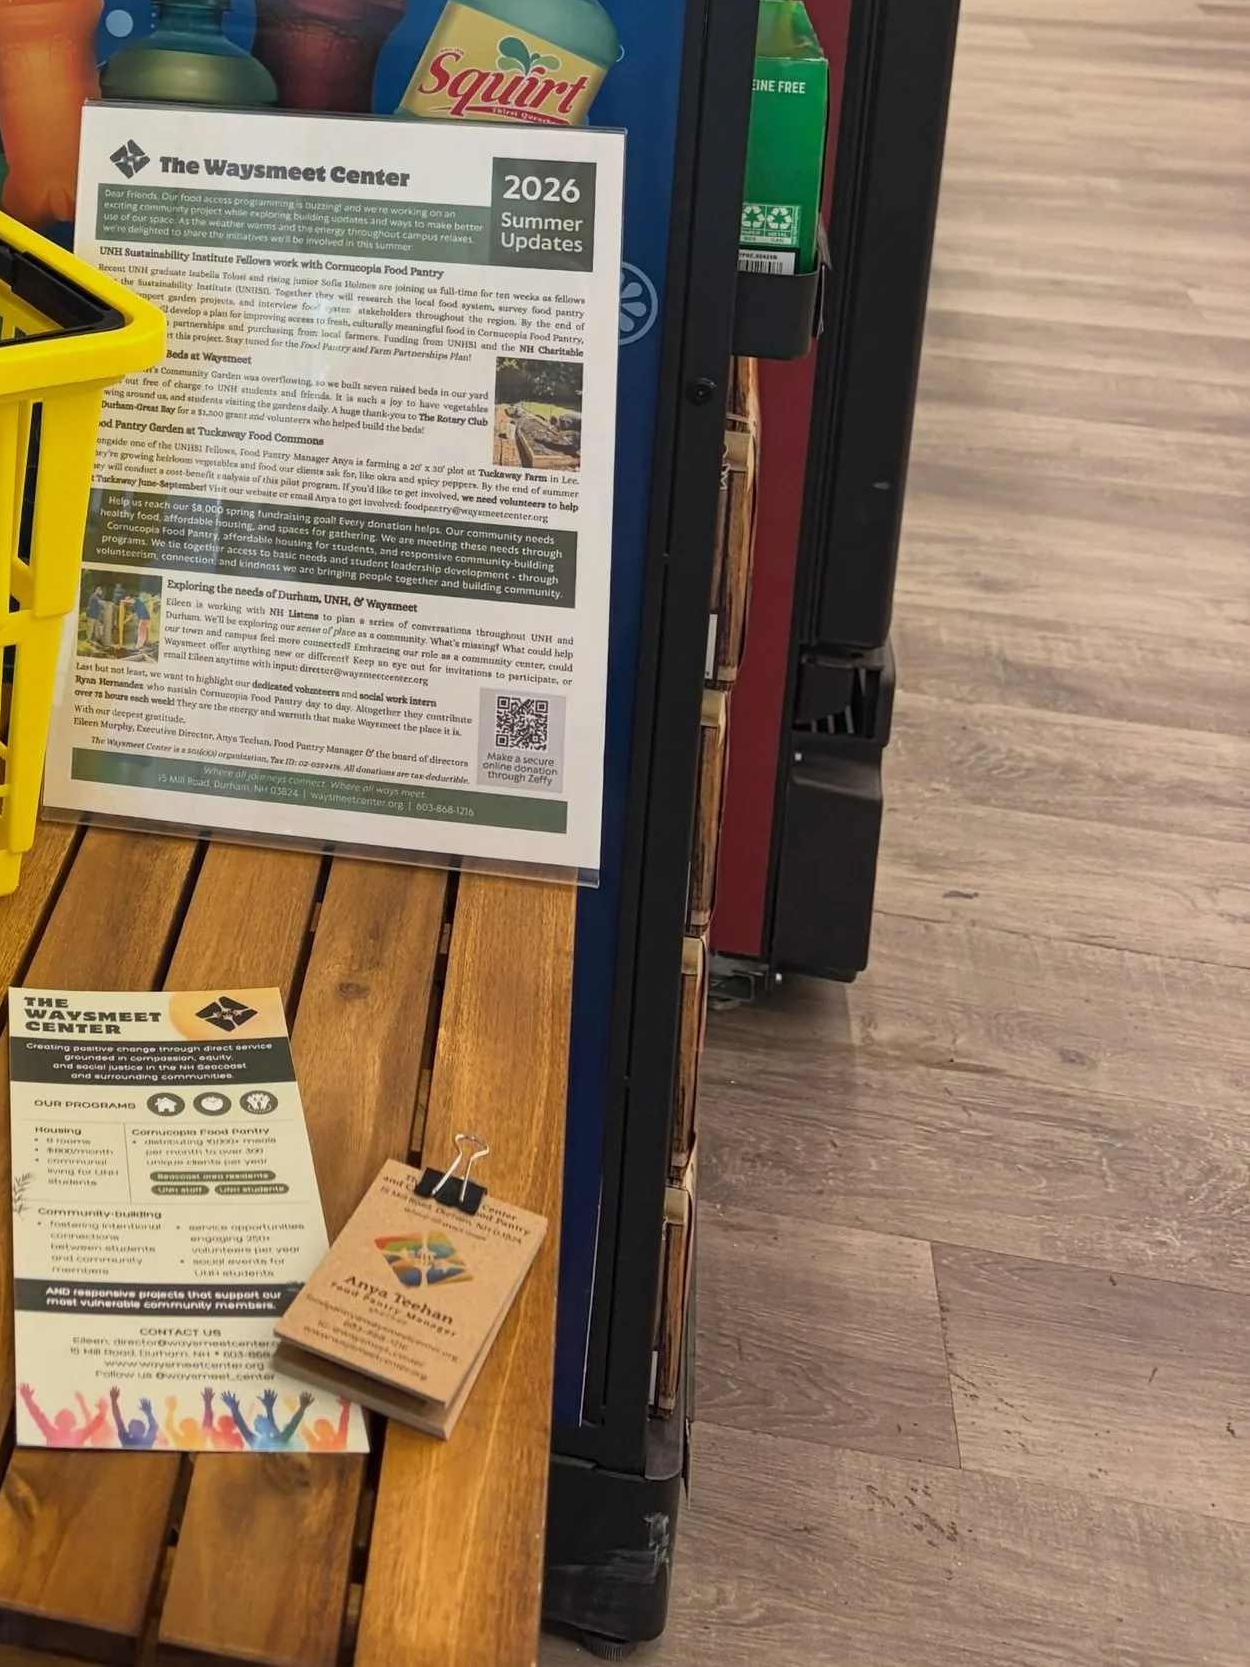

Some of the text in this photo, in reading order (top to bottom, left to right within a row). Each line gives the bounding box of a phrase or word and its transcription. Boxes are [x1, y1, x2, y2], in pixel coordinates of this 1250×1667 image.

[417, 51, 588, 117] Squirt
[777, 79, 806, 95] FREE
[159, 156, 410, 187] The Waysmeet Center
[502, 175, 581, 203] 2026
[500, 212, 584, 232] Summer
[500, 232, 584, 253] Updates
[487, 752, 513, 763] Make
[522, 757, 555, 767] secure
[483, 762, 558, 775] online donation
[487, 770, 553, 786] through Zeffy
[24, 996, 69, 1008] THE
[24, 1008, 162, 1022] WAYSMEET
[25, 1021, 121, 1034] CENTER
[34, 1100, 136, 1110] OUR PROGRAMS
[343, 1274, 454, 1325] Anya Teehan
